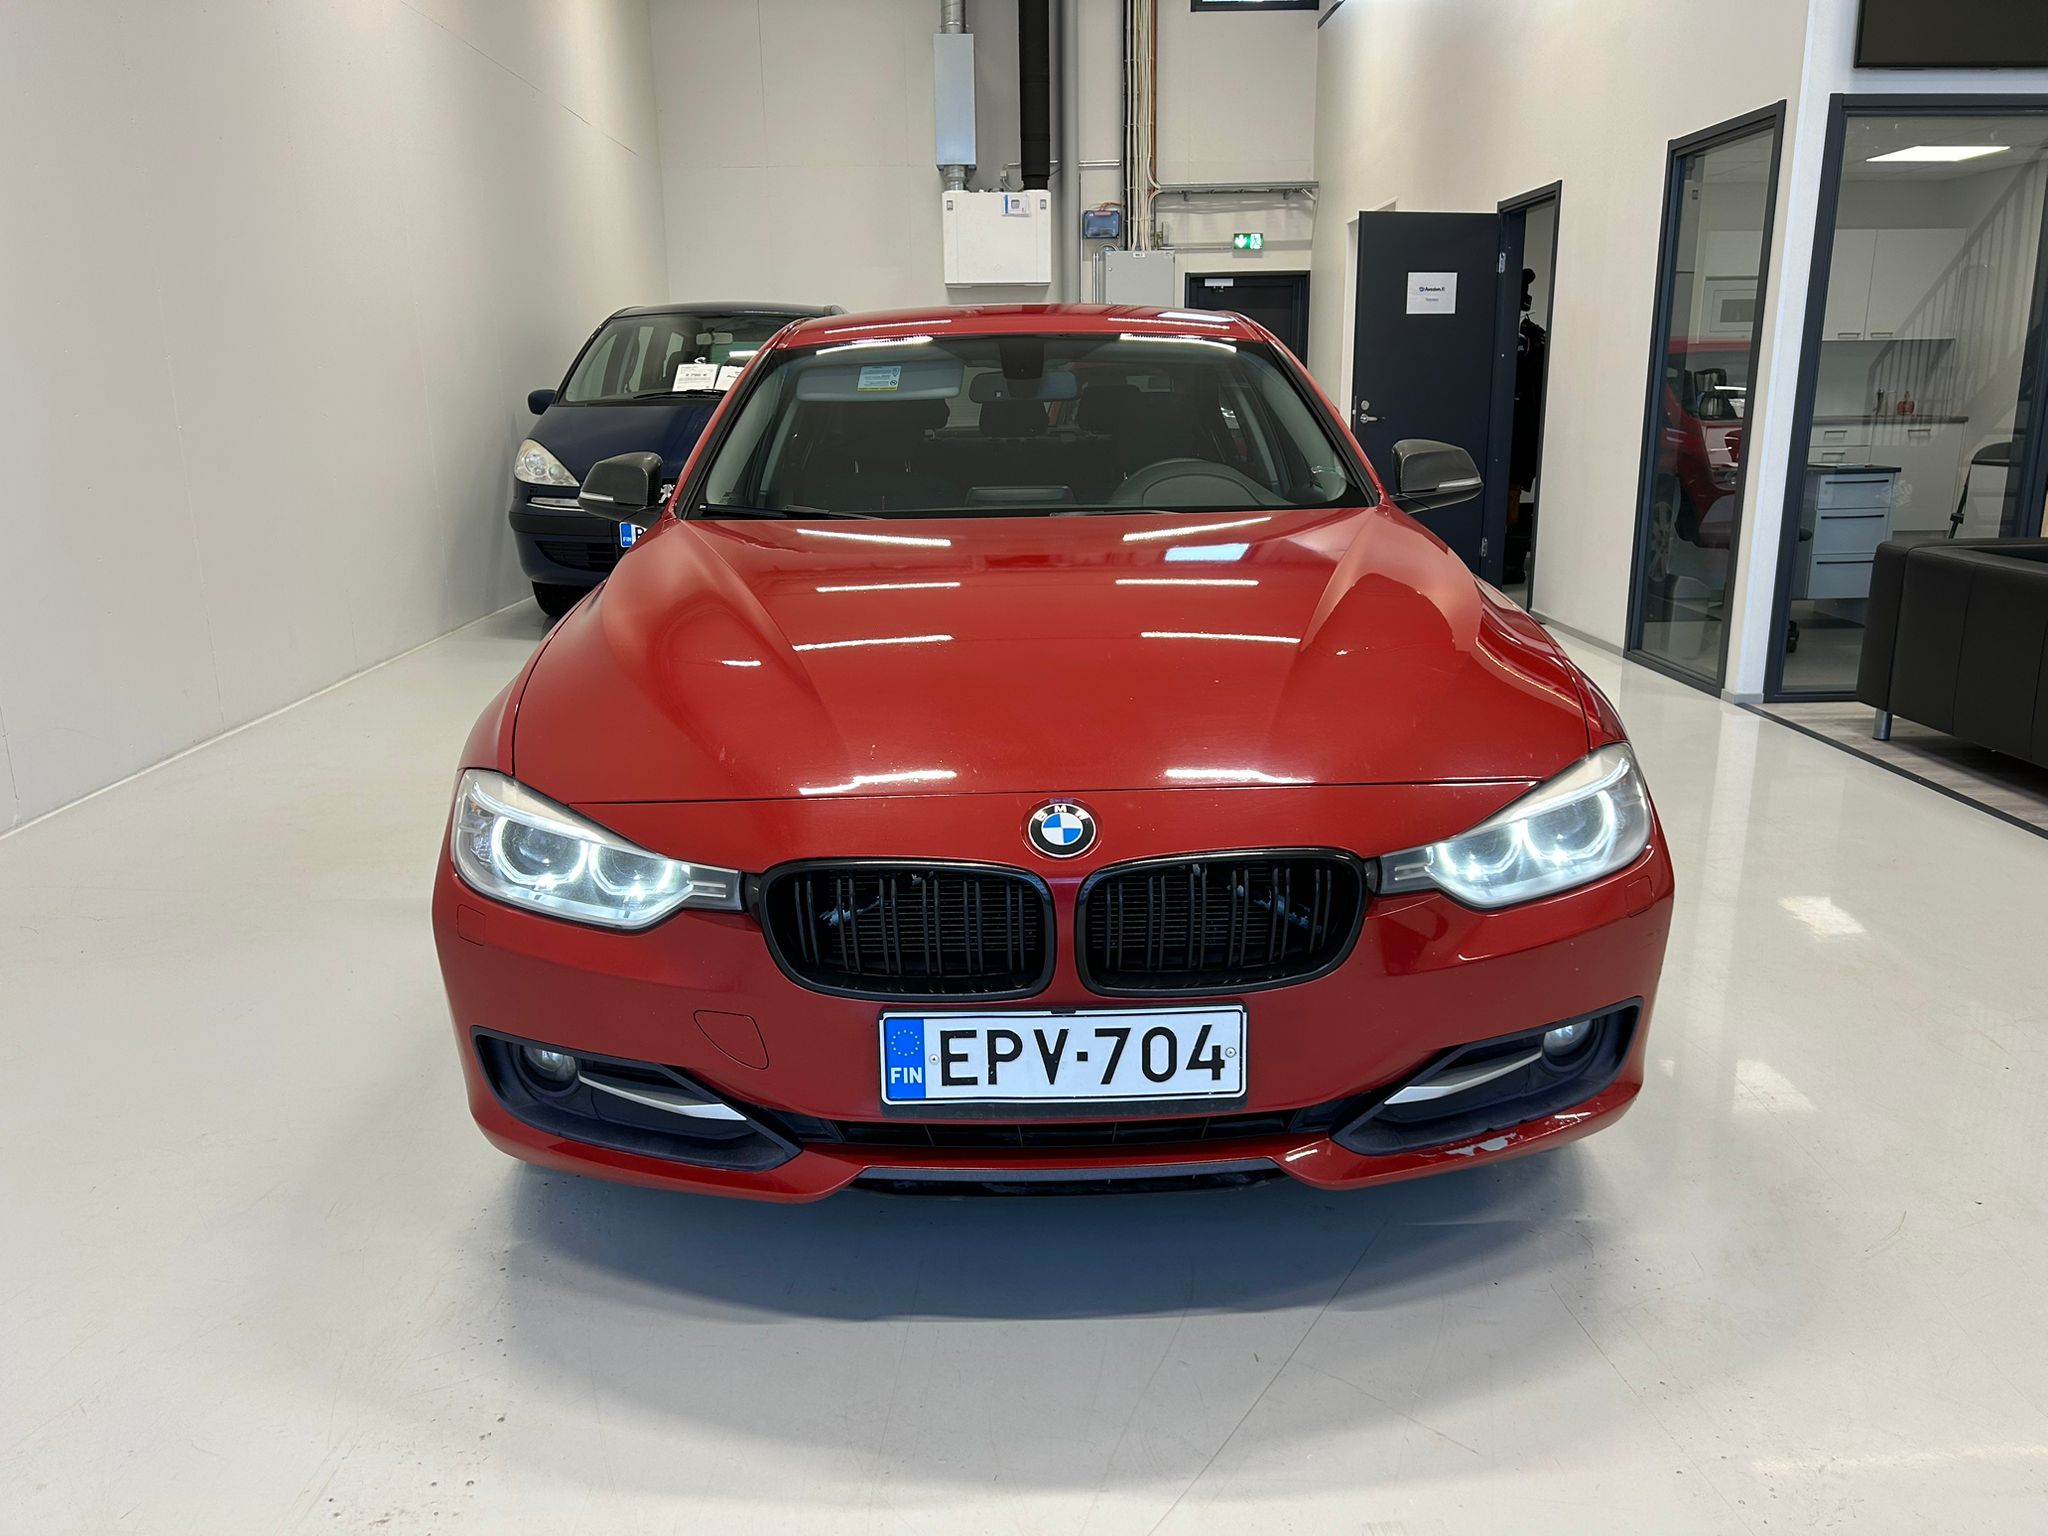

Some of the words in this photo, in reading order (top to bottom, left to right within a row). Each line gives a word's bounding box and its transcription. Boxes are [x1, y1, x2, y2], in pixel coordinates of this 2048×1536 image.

[1034, 805, 1090, 821] BMW
[940, 1024, 1226, 1086] EPV-704
[890, 1066, 923, 1084] FIN
